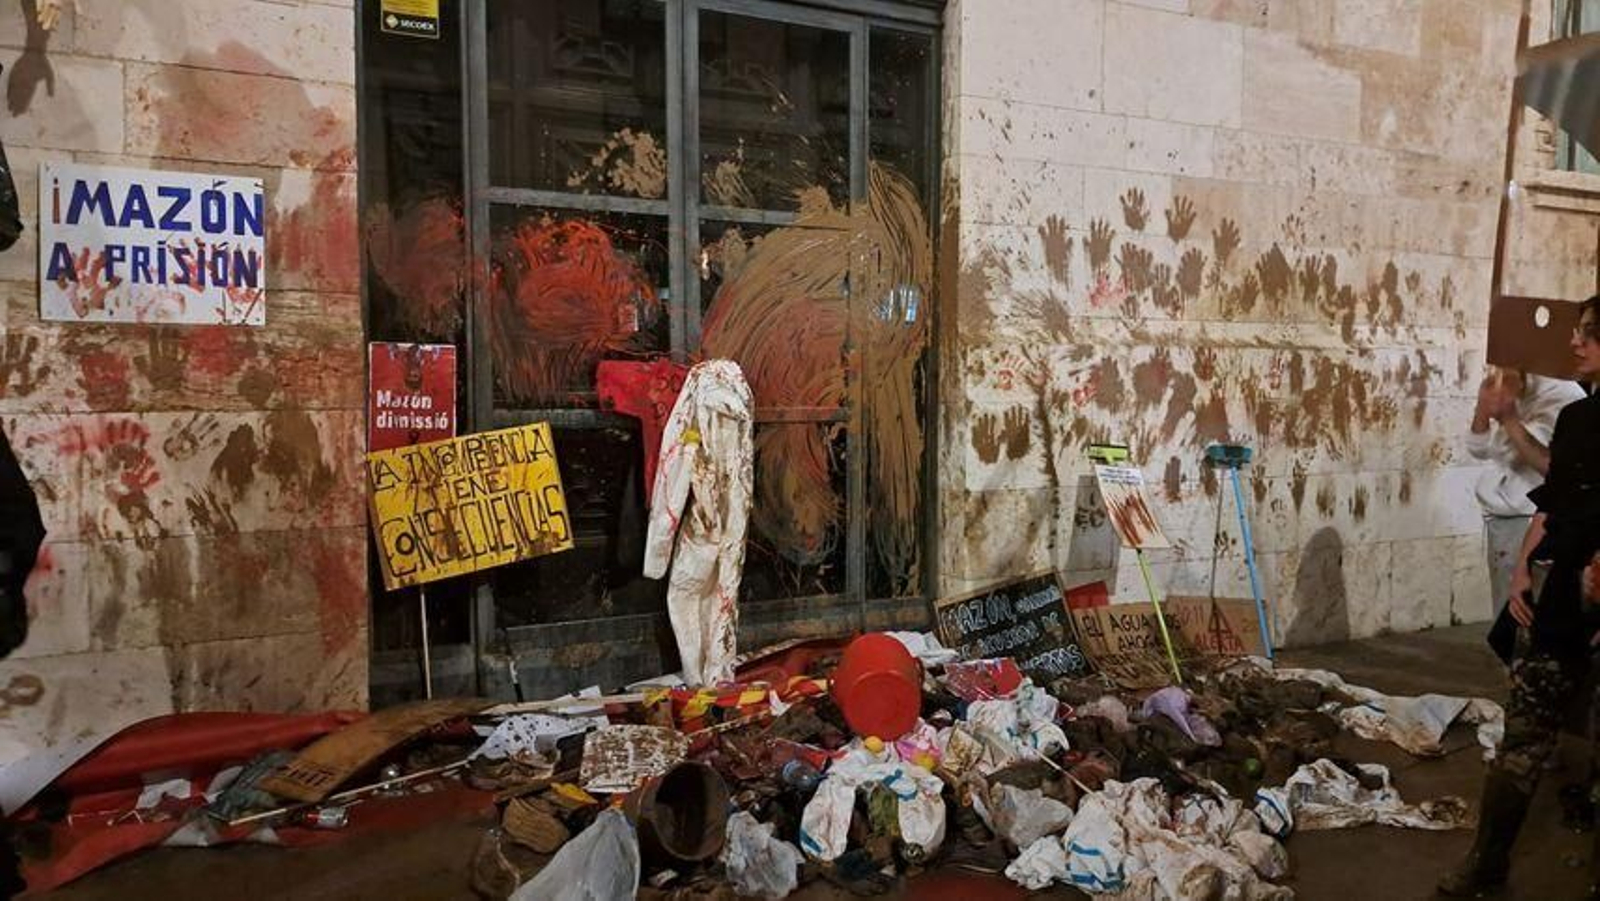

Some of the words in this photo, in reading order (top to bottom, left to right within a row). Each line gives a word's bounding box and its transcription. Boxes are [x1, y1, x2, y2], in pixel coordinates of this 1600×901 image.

[46, 242, 78, 281] A
[376, 388, 432, 410] Mazón
[376, 410, 449, 430] dimissió
[368, 457, 402, 492] LA
[427, 472, 508, 512] TIENE
[1082, 616, 1104, 637] EL
[1109, 612, 1151, 632] AGUA
[1194, 631, 1244, 653] ALERTA
